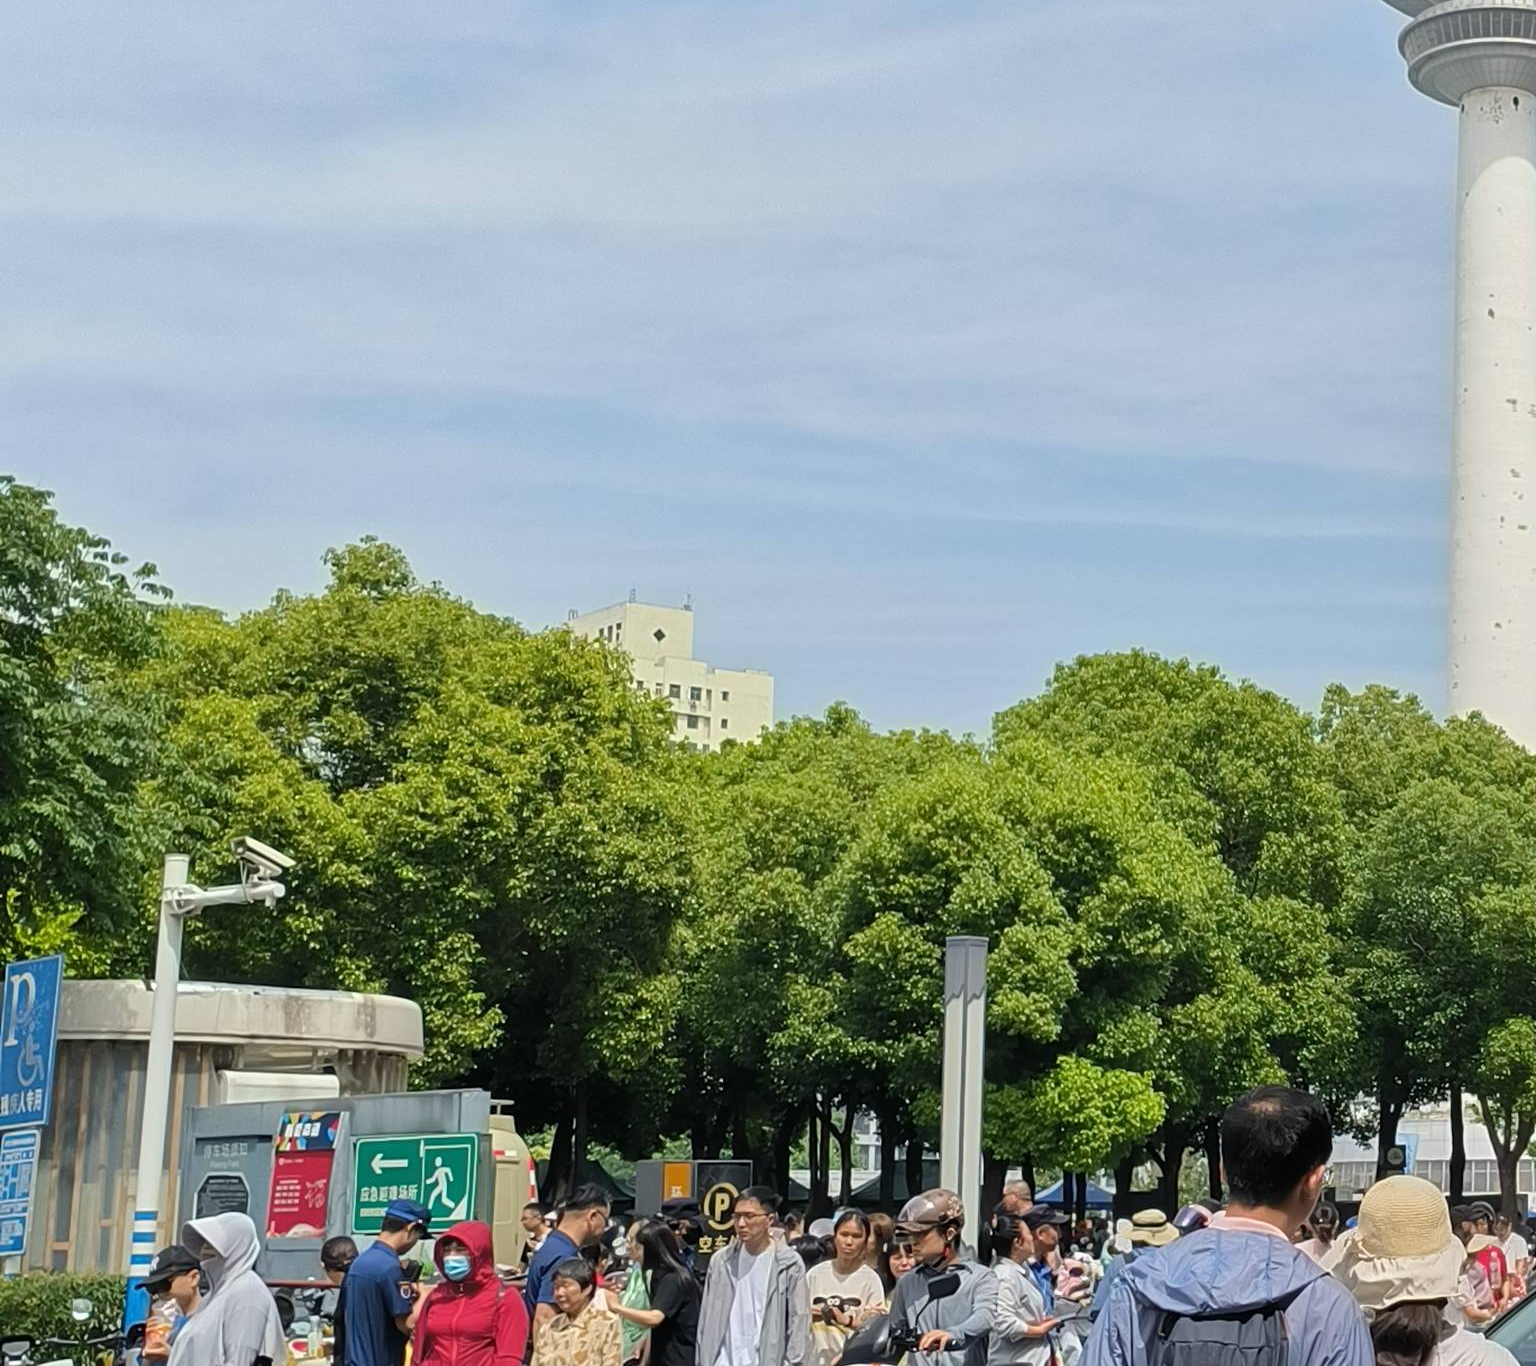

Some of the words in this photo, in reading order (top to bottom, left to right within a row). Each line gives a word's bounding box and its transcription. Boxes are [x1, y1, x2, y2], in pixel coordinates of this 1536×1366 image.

[361, 1185, 418, 1202] 应急避难场所
[715, 1193, 730, 1221] P
